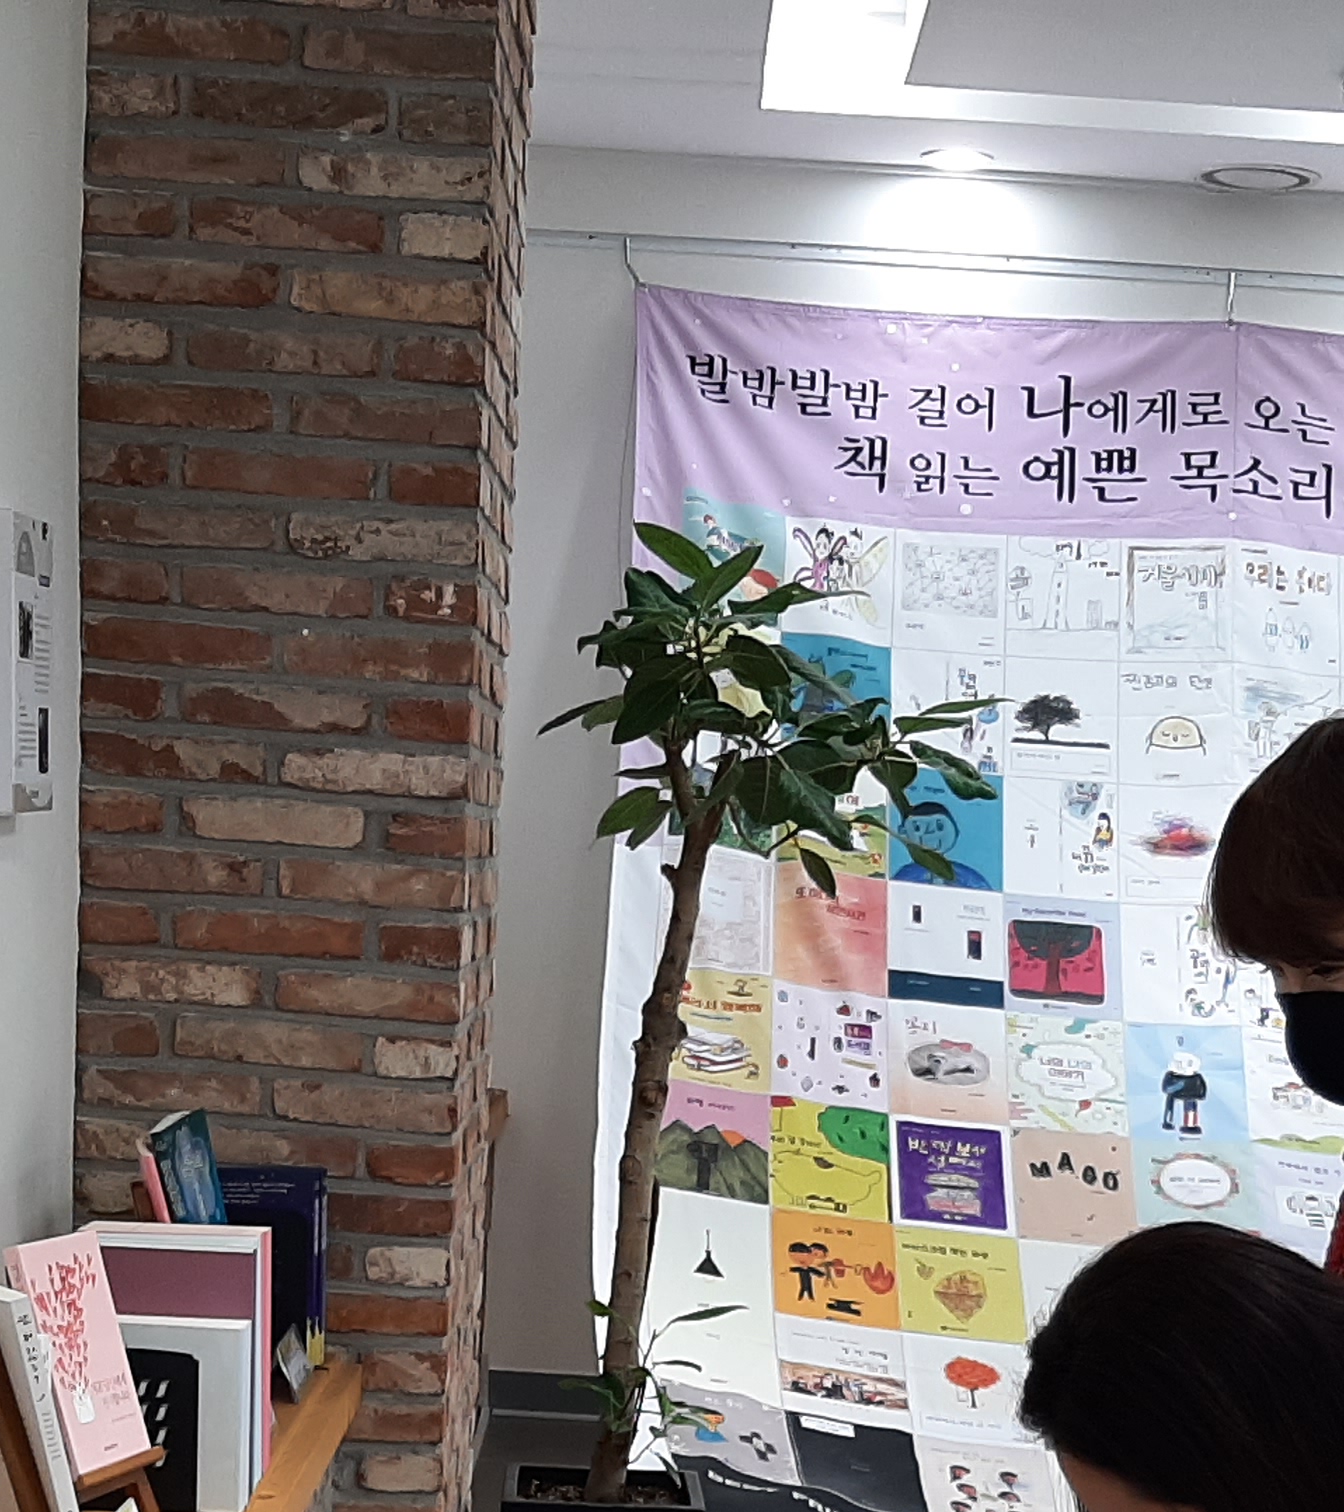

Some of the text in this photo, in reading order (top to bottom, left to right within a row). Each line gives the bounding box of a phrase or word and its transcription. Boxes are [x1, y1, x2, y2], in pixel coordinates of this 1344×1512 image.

[686, 352, 1337, 446] 발밤발밤 걸어 나에게로 오는
[833, 434, 1336, 519] 책 읽는 예쁜 목소리
